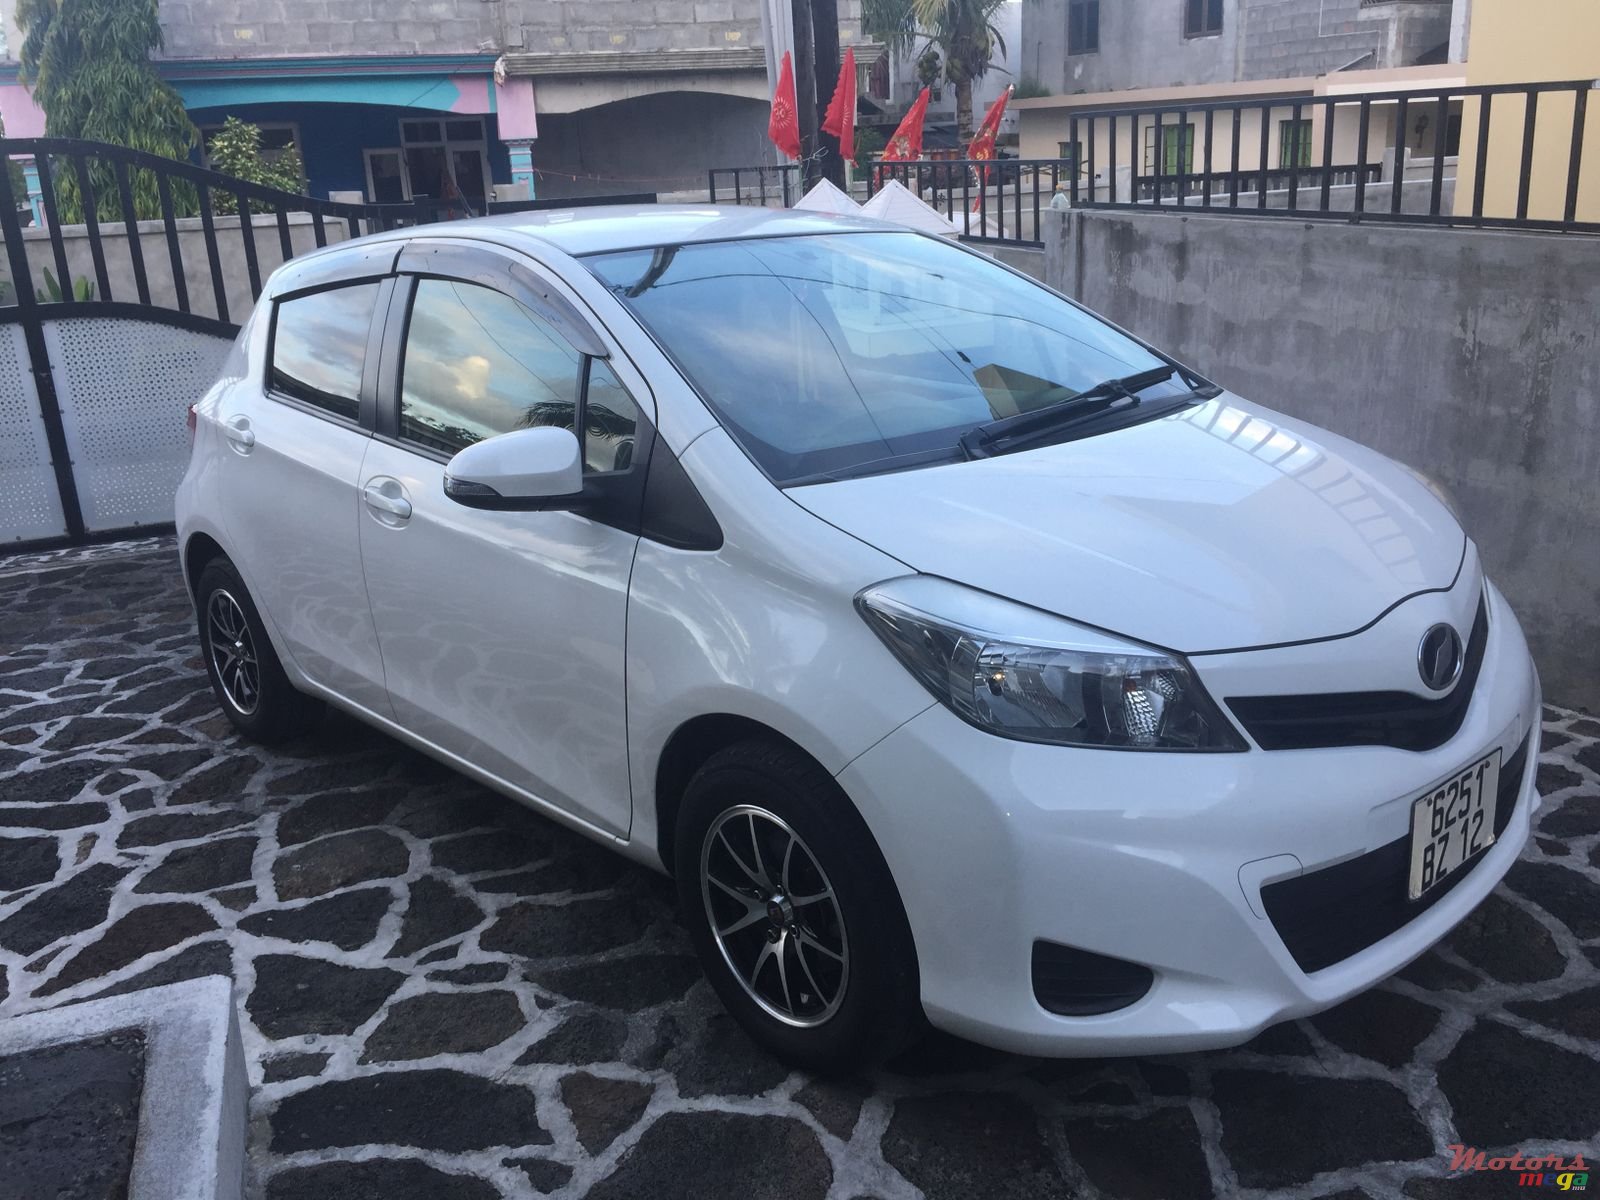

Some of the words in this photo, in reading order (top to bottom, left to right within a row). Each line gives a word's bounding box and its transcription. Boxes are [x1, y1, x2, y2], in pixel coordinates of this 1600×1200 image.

[1431, 764, 1485, 838] 6251
[1421, 832, 1450, 892] BZ
[1461, 809, 1484, 861] 12
